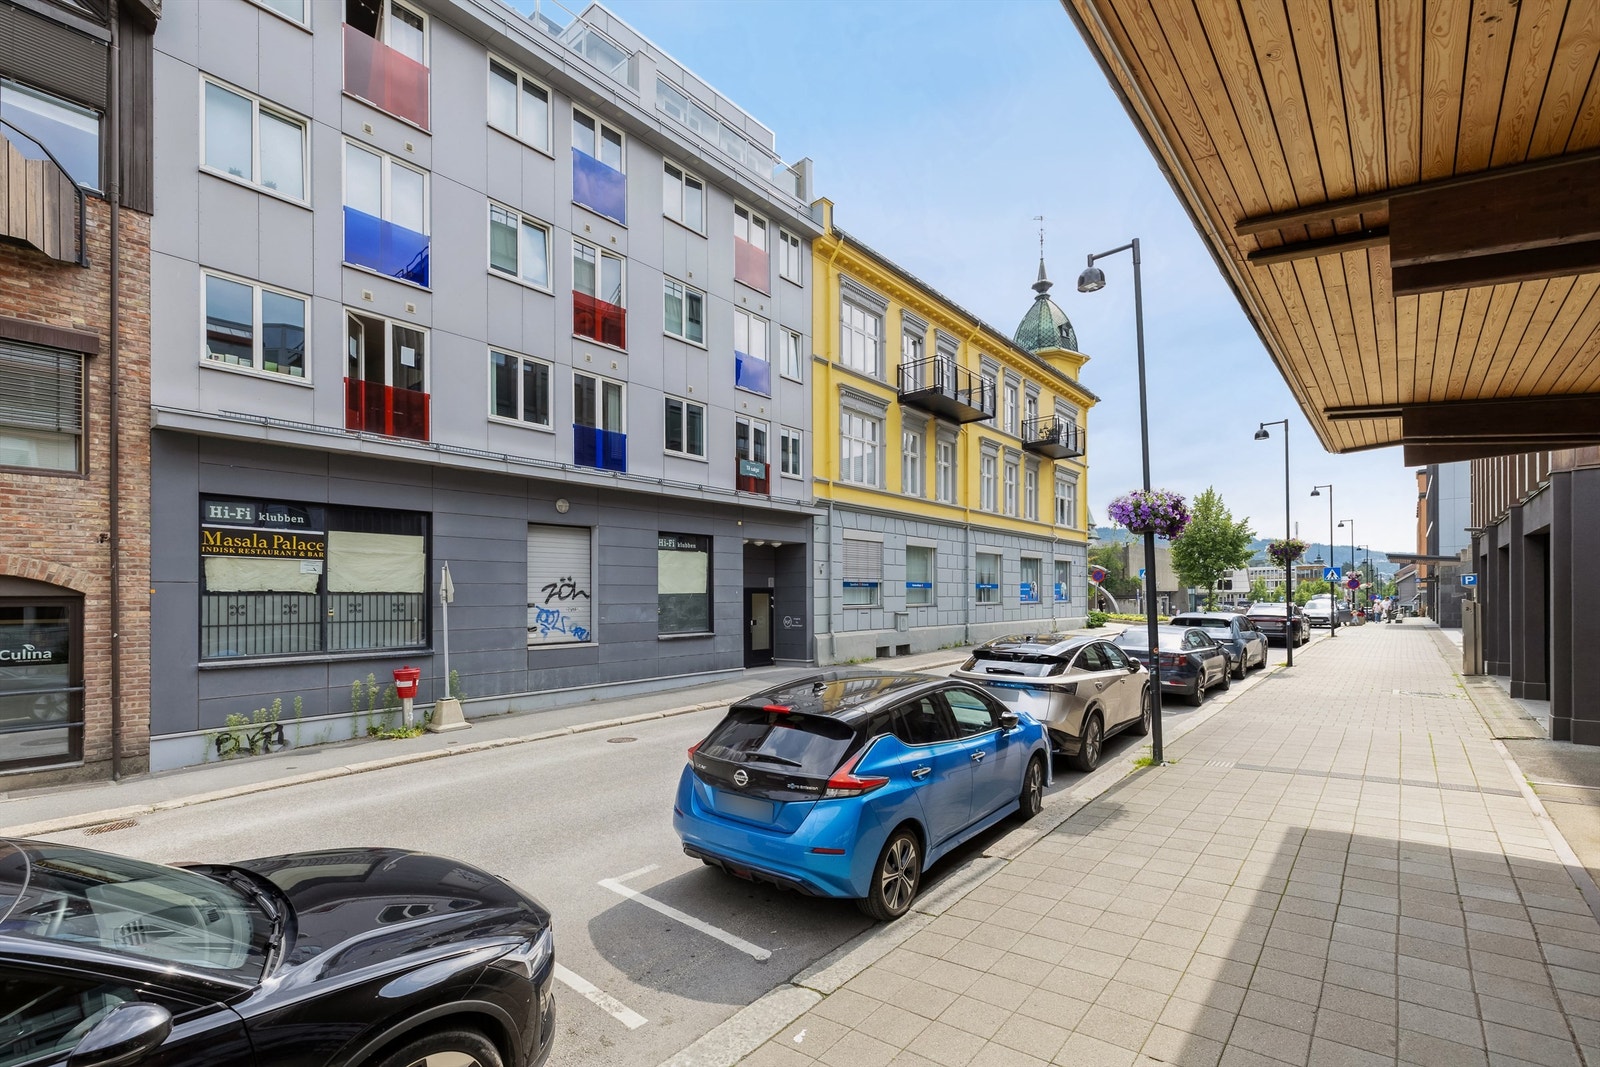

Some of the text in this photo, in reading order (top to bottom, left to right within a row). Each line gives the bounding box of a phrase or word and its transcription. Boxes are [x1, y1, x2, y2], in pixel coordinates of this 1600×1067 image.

[209, 505, 304, 523] Hi-Fi klubben
[202, 530, 324, 551] Masala Palace
[201, 546, 236, 554] INDISK
[238, 548, 297, 557] RESTAURANT
[1465, 576, 1474, 585] P
[0, 648, 52, 660] Culina
